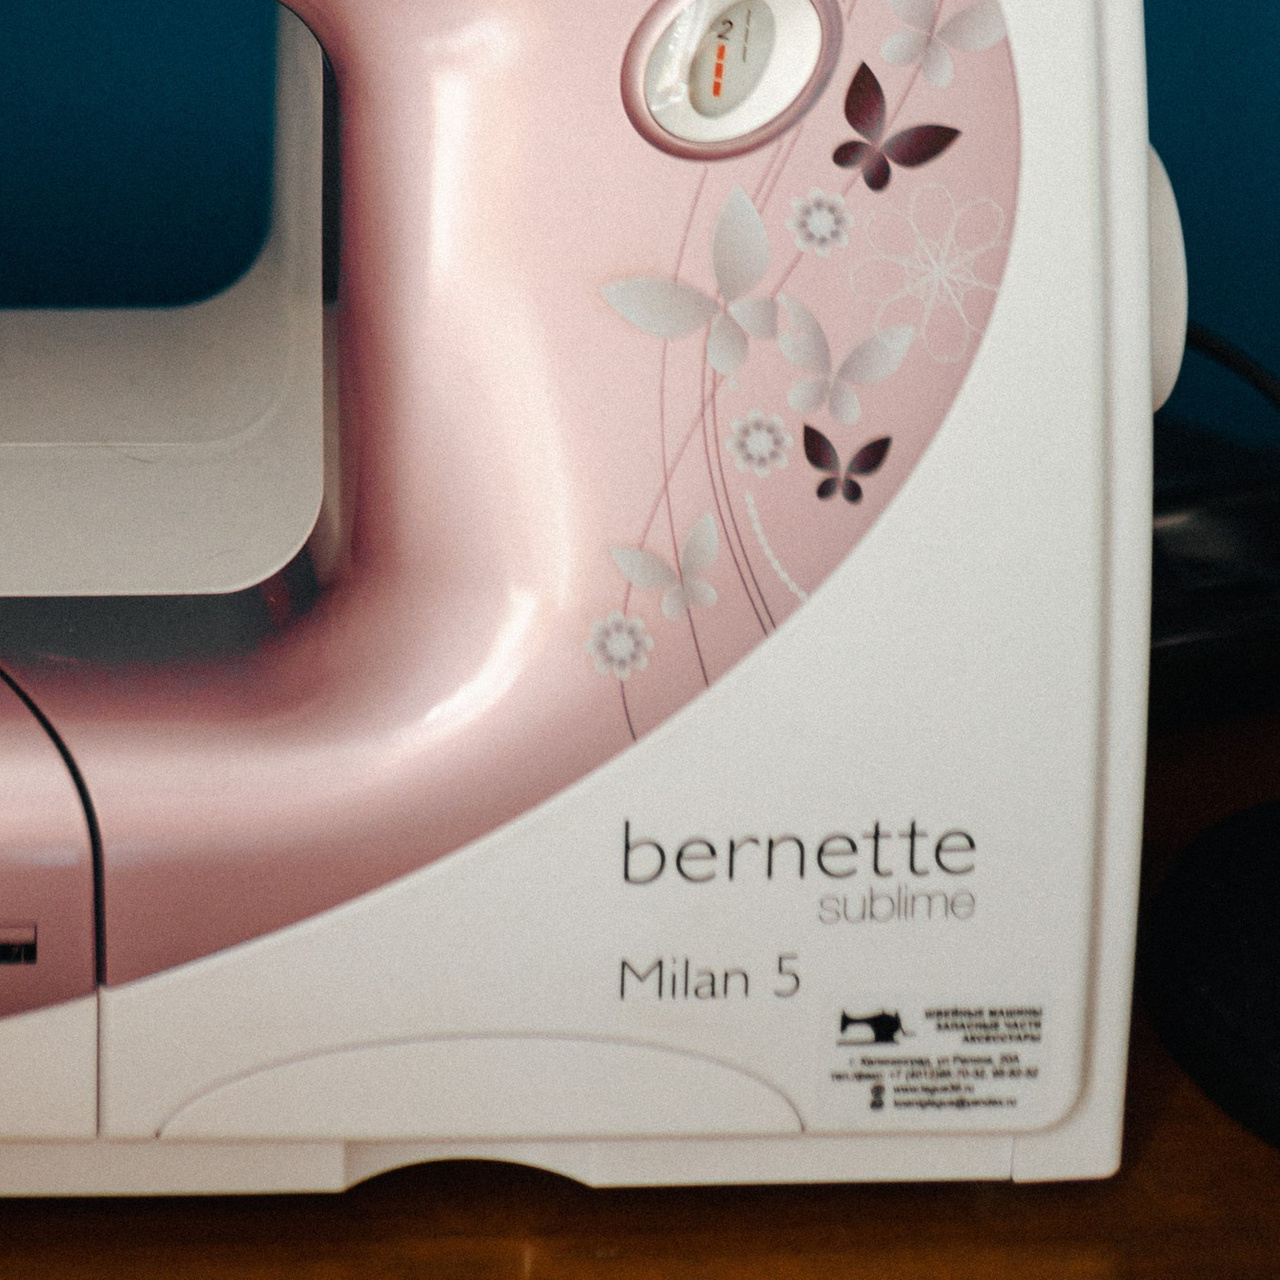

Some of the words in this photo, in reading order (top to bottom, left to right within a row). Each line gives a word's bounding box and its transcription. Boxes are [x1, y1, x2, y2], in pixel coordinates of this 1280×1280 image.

[717, 19, 734, 41] 2
[623, 820, 976, 884] bernette
[818, 885, 976, 924] sublime
[620, 956, 749, 1000] Milan
[774, 952, 801, 998] 5
